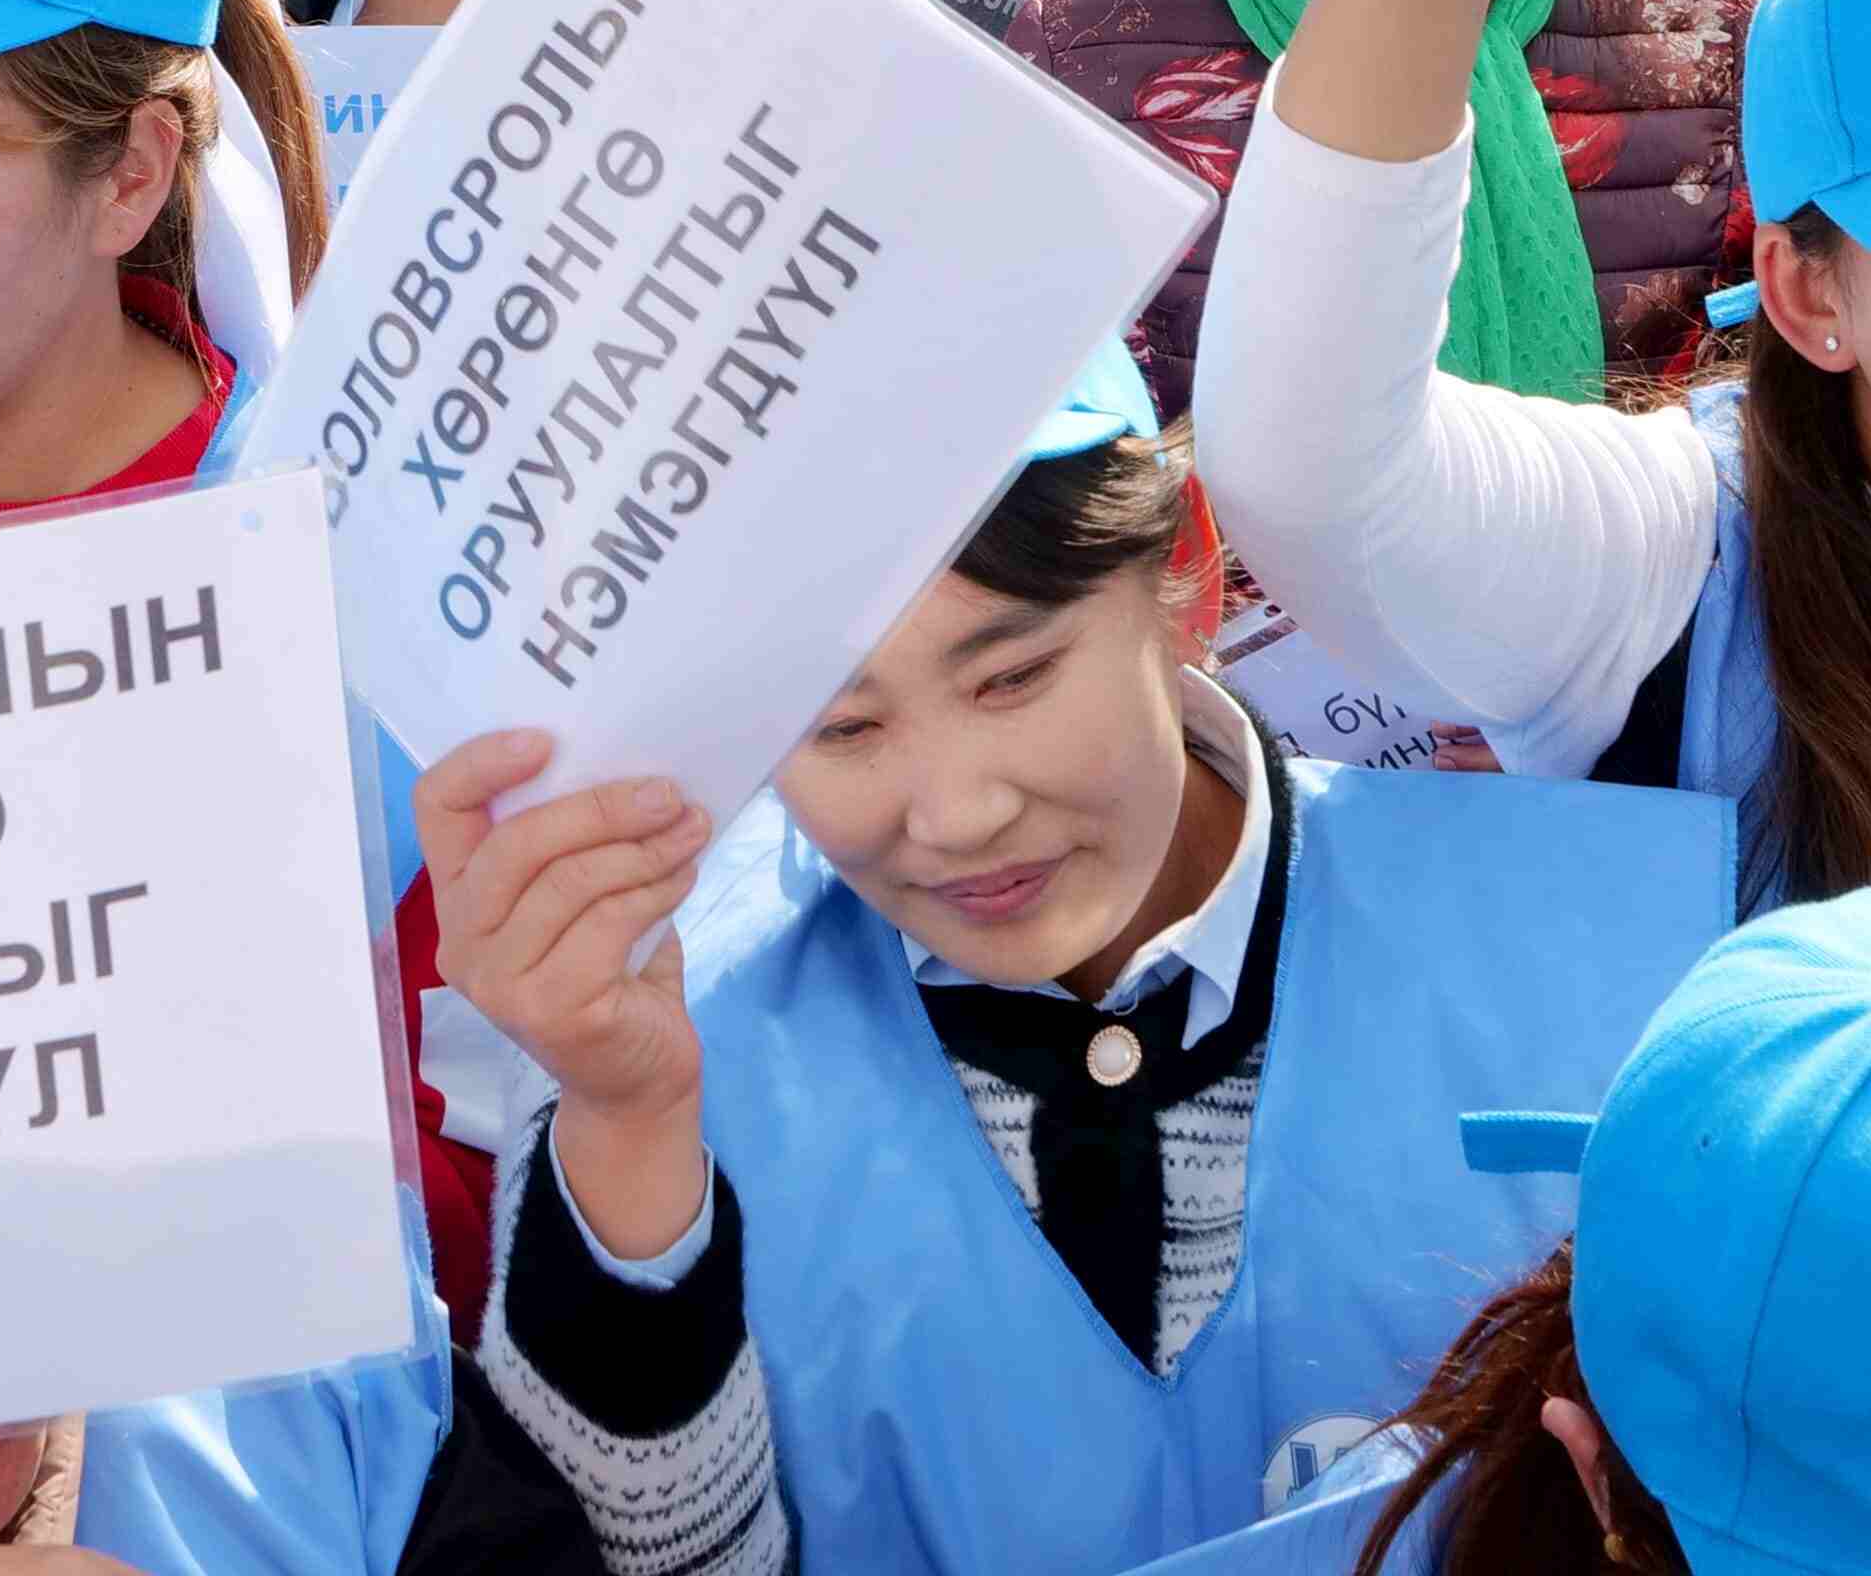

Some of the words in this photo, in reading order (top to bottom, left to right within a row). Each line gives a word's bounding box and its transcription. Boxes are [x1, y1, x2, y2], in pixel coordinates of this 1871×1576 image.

[401, 127, 665, 514] ХӨРӨНГӨ
[436, 101, 803, 644] ОРУУЛАЛТЫГ
[521, 206, 882, 691] НЭМЭГДҮҮЛ
